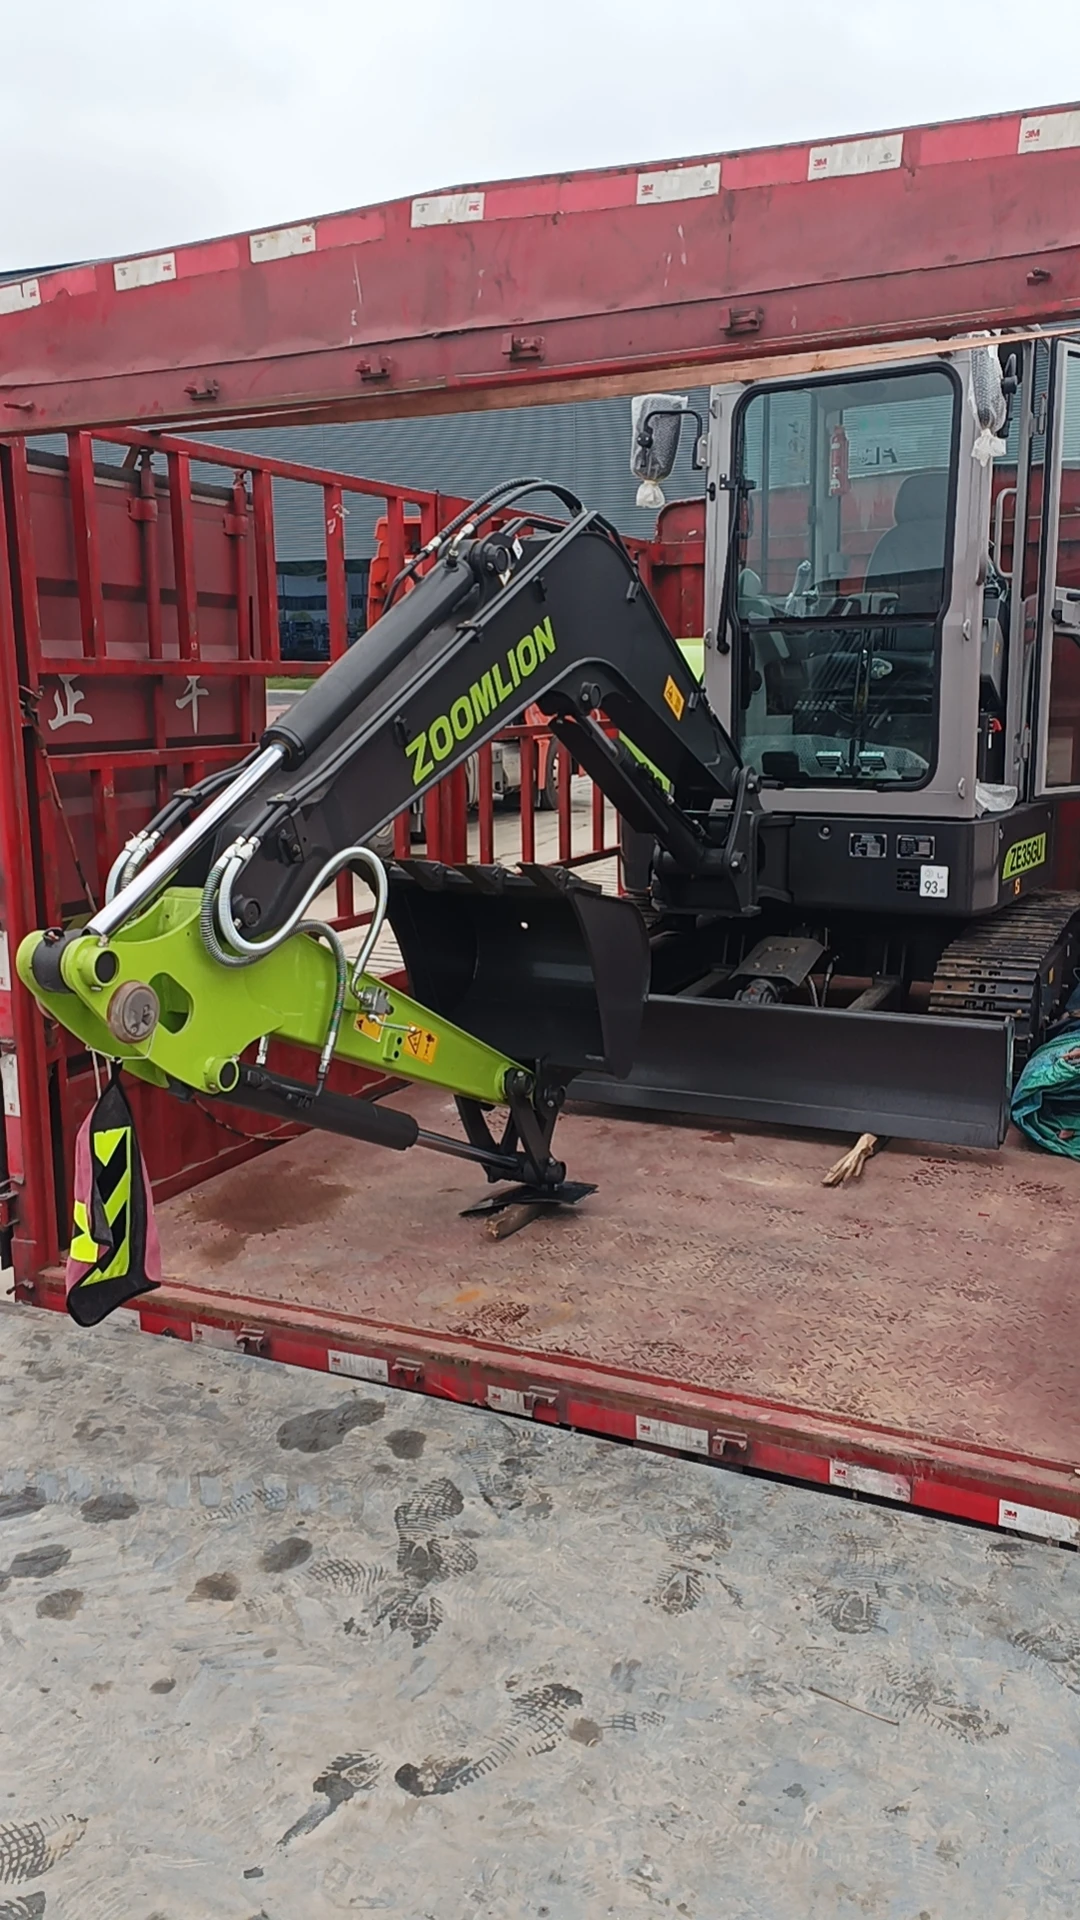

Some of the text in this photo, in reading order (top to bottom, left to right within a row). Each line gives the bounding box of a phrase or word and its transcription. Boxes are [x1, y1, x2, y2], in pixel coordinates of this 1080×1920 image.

[1024, 128, 1040, 139] 3M
[813, 157, 828, 167] 3M
[641, 183, 654, 193] 3M
[405, 615, 557, 786] ZOOMLION
[1009, 837, 1044, 872] ZE35GU
[924, 880, 938, 895] 93
[834, 1468, 847, 1477] 3M
[1003, 1509, 1018, 1518] 3M
